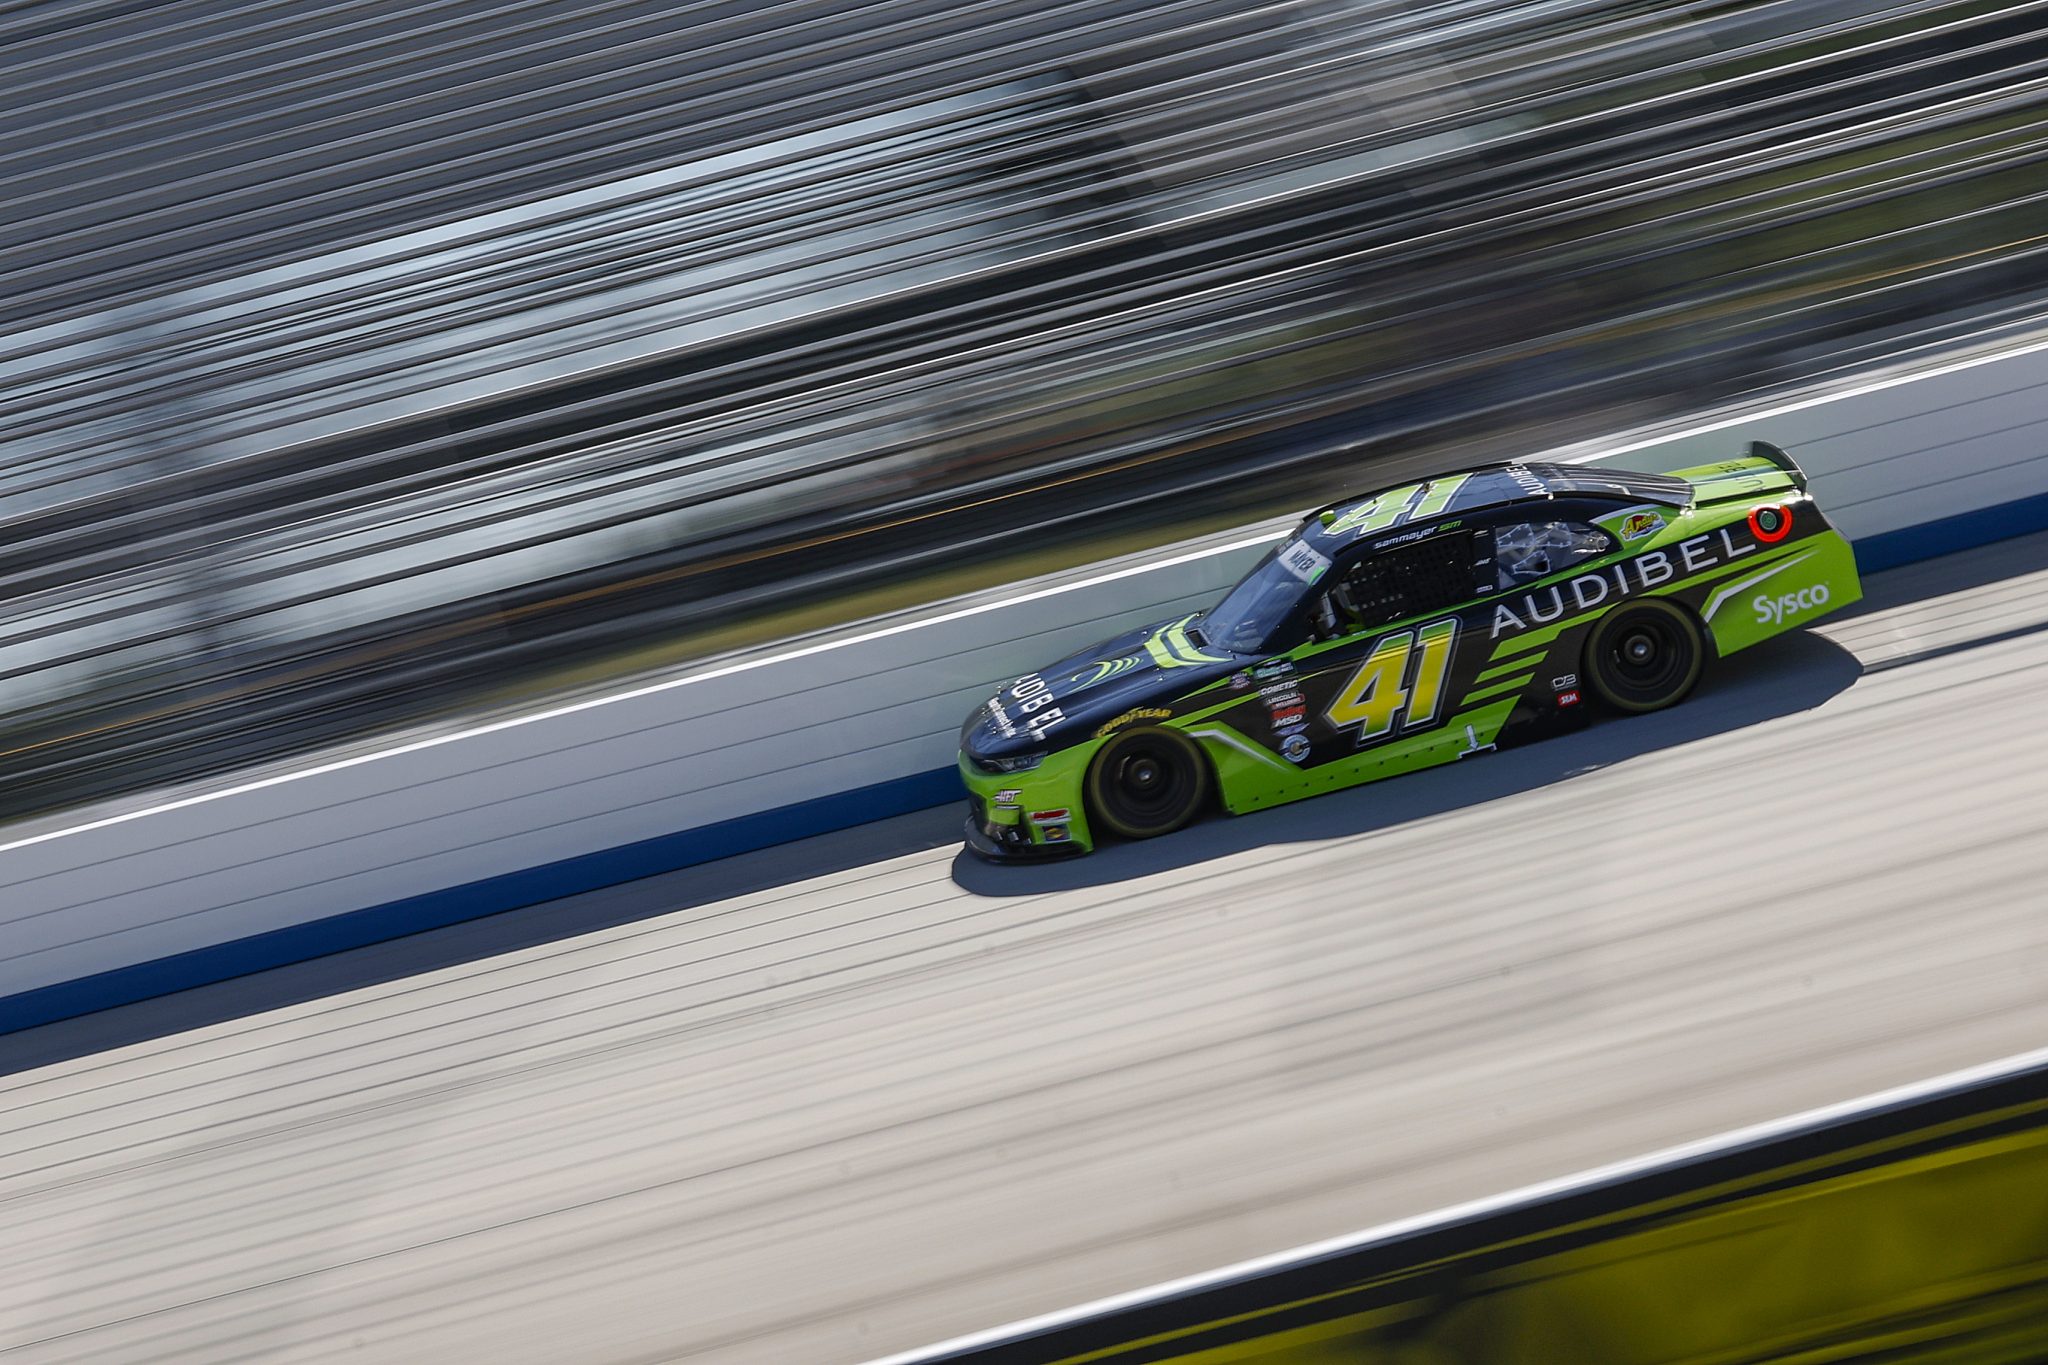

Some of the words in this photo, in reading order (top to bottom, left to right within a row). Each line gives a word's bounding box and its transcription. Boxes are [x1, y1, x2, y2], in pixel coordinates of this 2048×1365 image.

[1322, 473, 1474, 536] 41
[1374, 526, 1437, 549] sammayer
[1490, 529, 1756, 640] AUDIBEL
[1753, 583, 1830, 624] Sysco
[1260, 679, 1298, 696] COMETIC
[1322, 617, 1457, 743] 41
[1096, 706, 1173, 738] GOODYEAR
[1275, 714, 1303, 728] MSD
